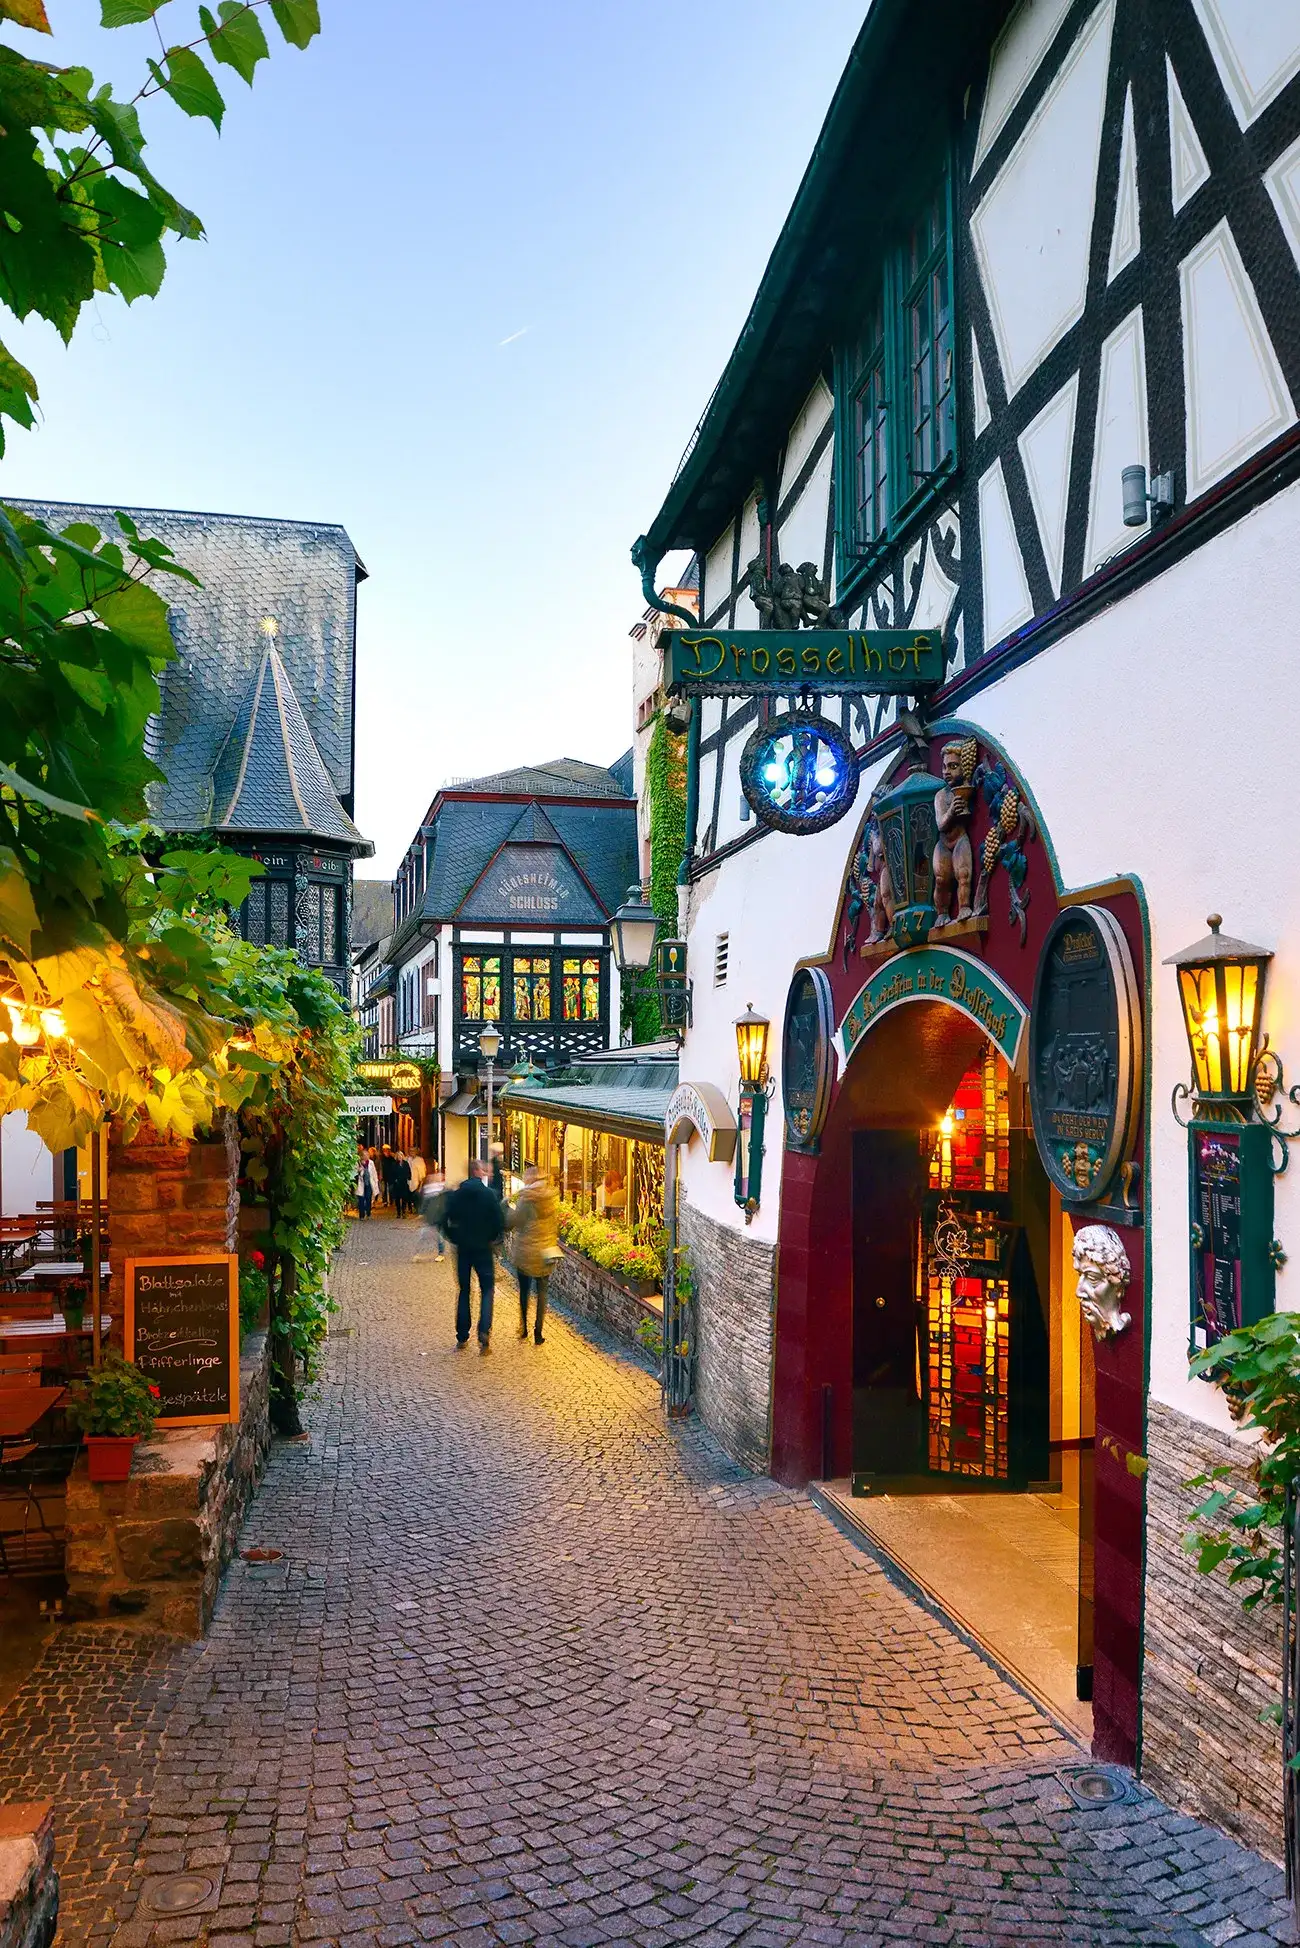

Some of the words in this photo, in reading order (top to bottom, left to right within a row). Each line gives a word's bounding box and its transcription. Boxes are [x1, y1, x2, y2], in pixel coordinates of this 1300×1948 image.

[679, 634, 933, 678] Drosselhof
[509, 895, 558, 910] SCHLOSS
[929, 966, 945, 992] der
[390, 1075, 421, 1089] SCHLOSS
[139, 1273, 225, 1292] Blattsalate
[138, 1353, 223, 1374] Pfifferlinge
[159, 1387, 228, 1408] sespätzle
